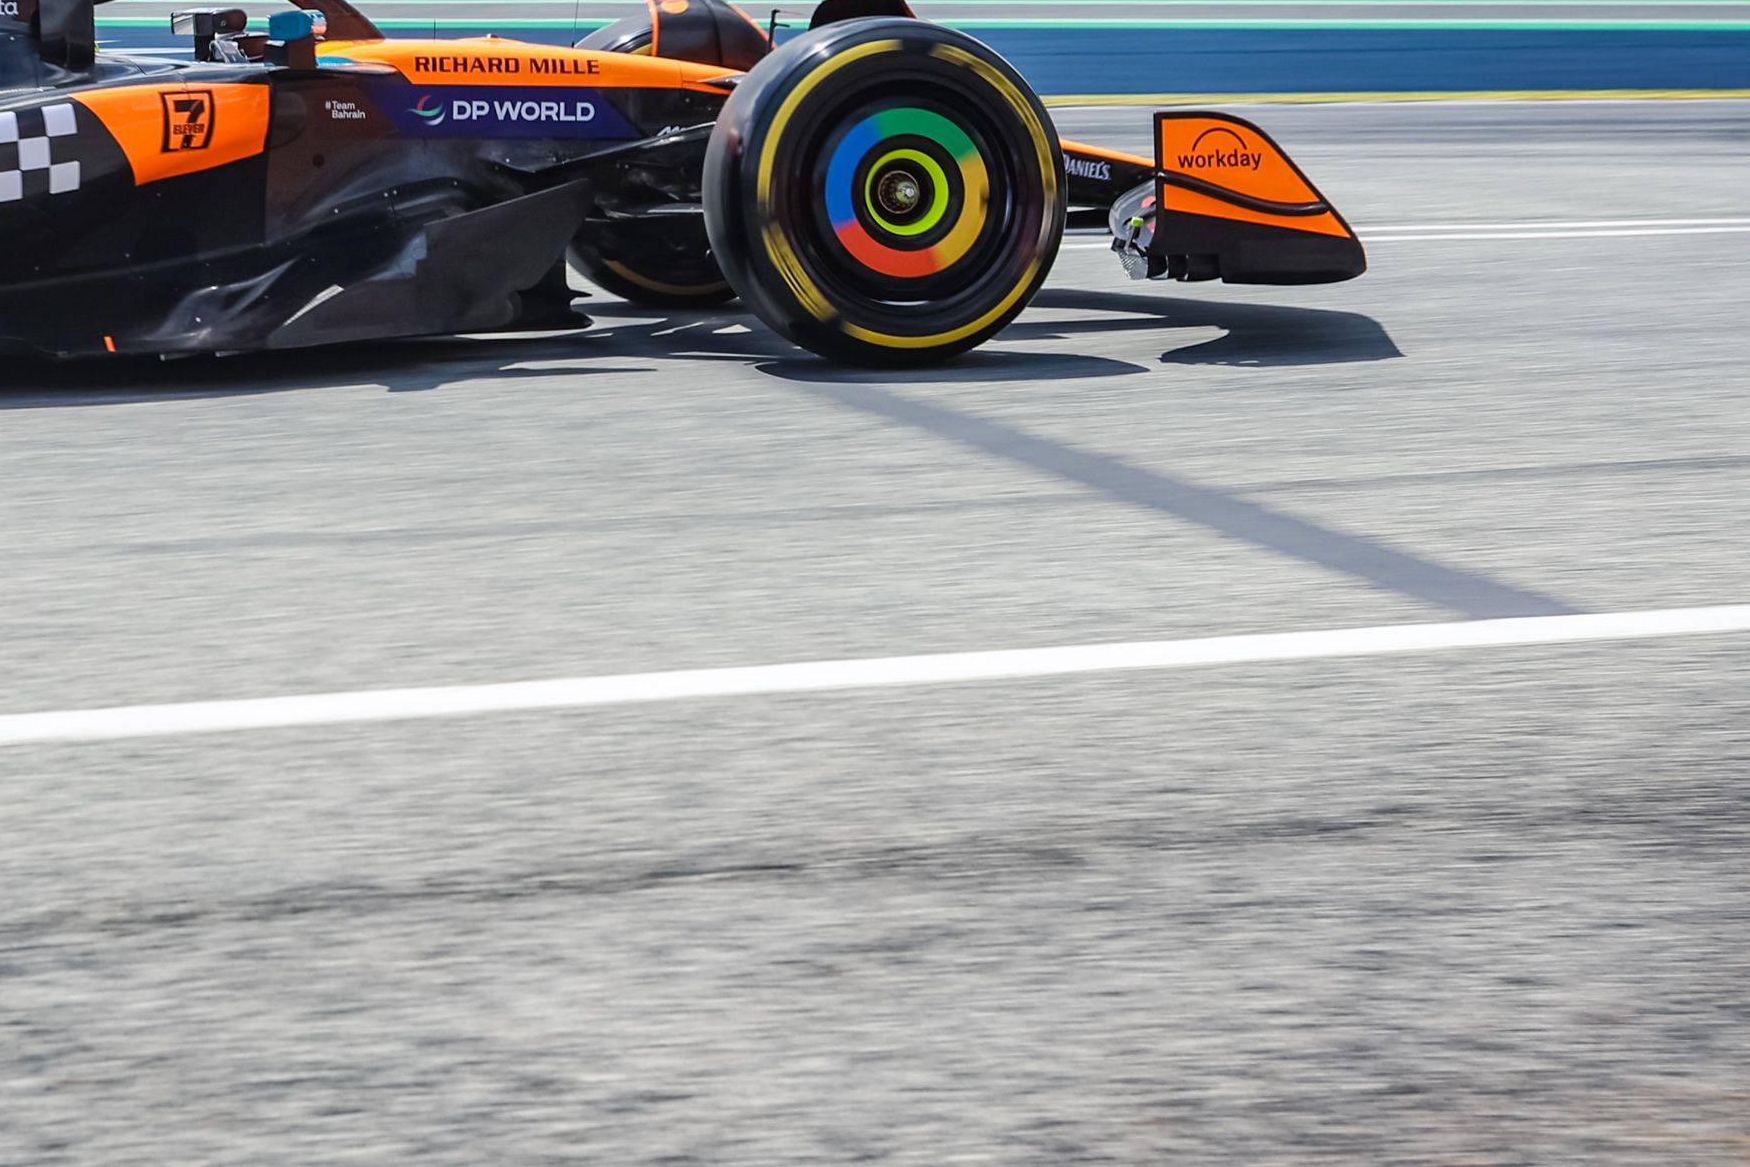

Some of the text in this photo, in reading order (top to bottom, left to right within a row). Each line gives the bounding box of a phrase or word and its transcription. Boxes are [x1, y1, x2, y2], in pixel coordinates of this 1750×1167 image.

[414, 56, 600, 75] RICHARD MILLE
[332, 109, 366, 119] Bahrain
[453, 100, 595, 122] DP WORLD
[1177, 148, 1262, 171] workday
